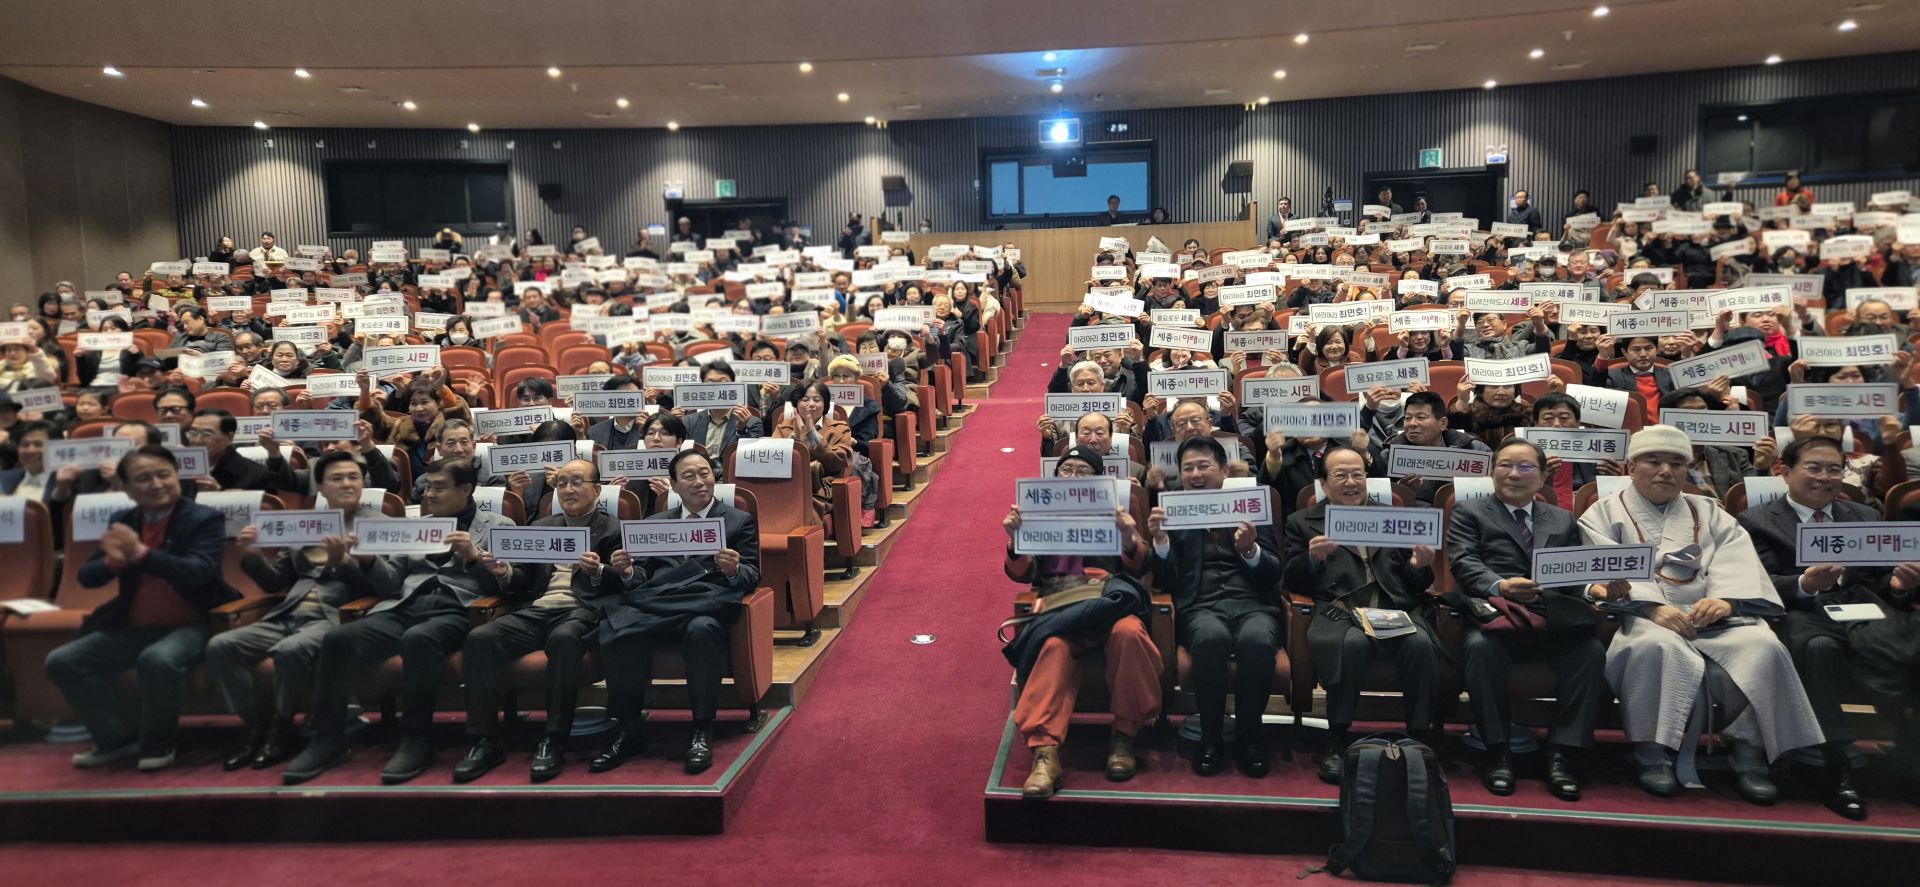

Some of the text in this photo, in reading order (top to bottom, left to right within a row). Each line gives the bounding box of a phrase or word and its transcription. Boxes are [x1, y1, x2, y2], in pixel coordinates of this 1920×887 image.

[1246, 288, 1271, 298] 최민호!
[1534, 288, 1575, 299] 요로운 세종
[1759, 292, 1782, 304] 세종
[1510, 296, 1529, 307] 세종
[1659, 296, 1689, 308] 세종이
[1338, 306, 1368, 319] 최민호!
[1615, 316, 1682, 330] 세종이 미래다
[1099, 331, 1131, 342] 최민호!
[1157, 332, 1205, 345] 세종이 미래다
[1229, 335, 1282, 348] 세종이 미래다
[407, 351, 429, 364] 시민
[1844, 343, 1890, 358] 최민호!
[764, 367, 783, 378] 세종
[1471, 362, 1544, 378] 아리아리 최민호!
[1681, 352, 1757, 379] 세종이 미래다
[1356, 366, 1420, 383] 풍요로운 세종
[1156, 376, 1219, 390] 세종이 미래다
[681, 388, 738, 402] 풍요로운 세종
[837, 390, 856, 400] 시민
[1252, 384, 1312, 398] 품격있는 시민
[607, 397, 640, 409] 최민호!
[1050, 399, 1116, 412] 아리아리 최민호!
[1856, 392, 1887, 407] 시민
[513, 413, 547, 426] 최민호!
[1310, 412, 1352, 428] 최민호!
[1725, 421, 1757, 436] 시민
[1536, 438, 1617, 453] 풍요로운 세종
[499, 448, 565, 467] 풍요로운 세종
[742, 449, 785, 464] 내빈석
[608, 457, 670, 472] 풍요로운 세종
[1396, 456, 1485, 473] 미래전략도시 세종
[1024, 487, 1109, 505] 세종이 미래다
[1166, 496, 1263, 518] 미래전략도시 세종
[259, 518, 336, 537] 세종이 미래다
[1334, 518, 1434, 537] 아리아리 최민호!
[365, 528, 444, 544] 품격있는 시민
[628, 528, 718, 546] 미래전략도시 세종
[1022, 528, 1114, 545] 아리아리 최민호!
[499, 537, 577, 554] 풍요로운 세종
[1809, 533, 1919, 555] 세종이 미래다
[1540, 554, 1646, 576] 아리아리 최민호!
